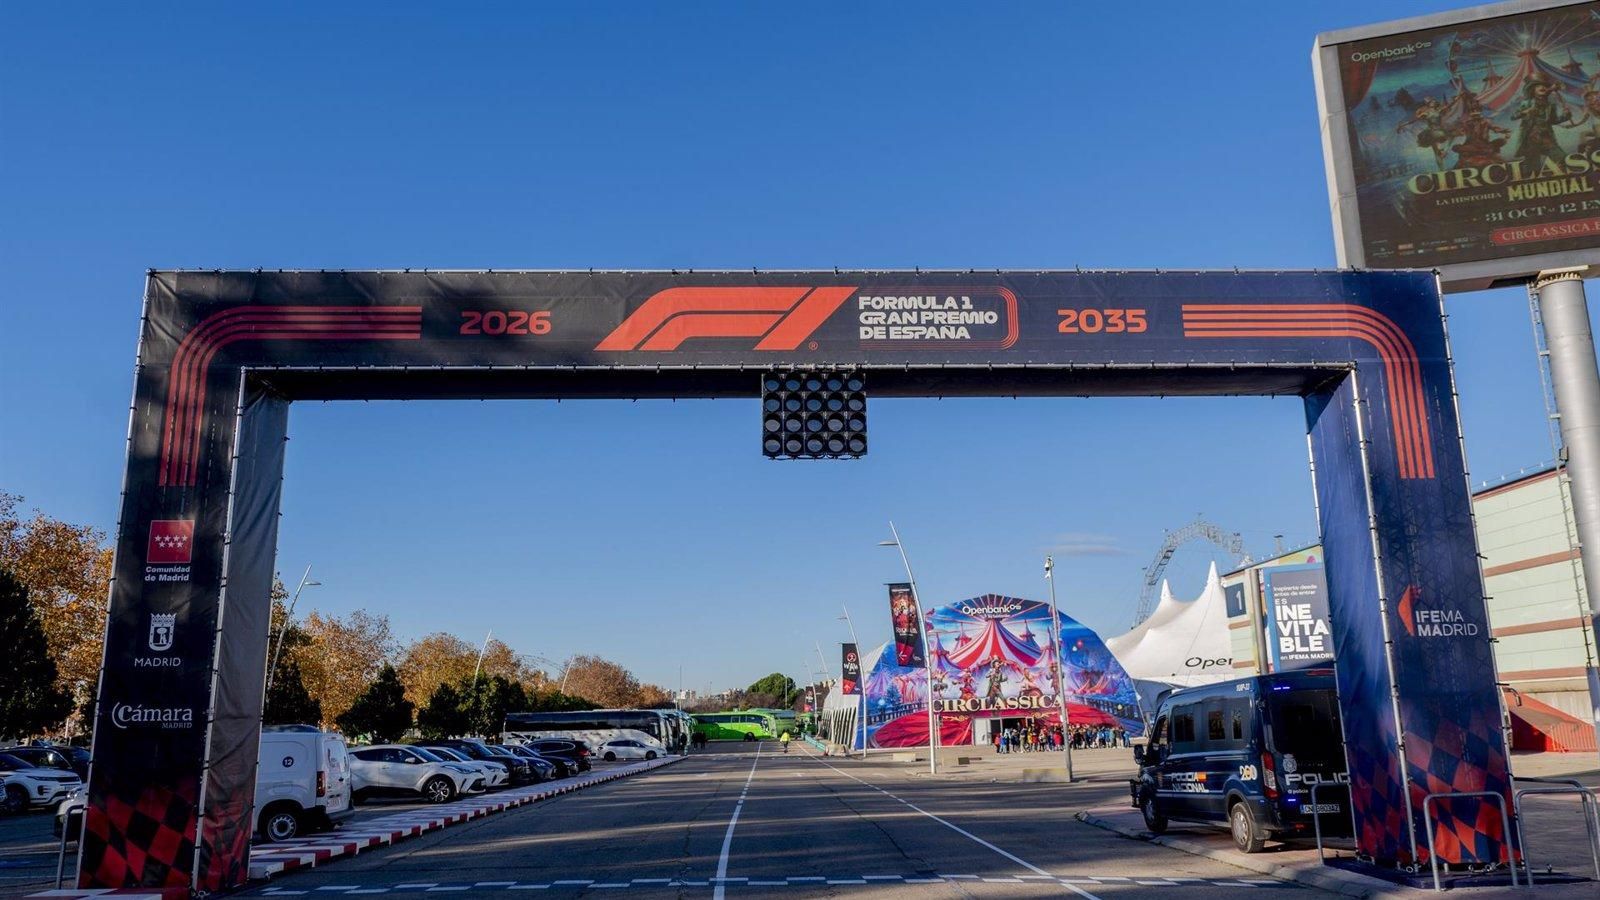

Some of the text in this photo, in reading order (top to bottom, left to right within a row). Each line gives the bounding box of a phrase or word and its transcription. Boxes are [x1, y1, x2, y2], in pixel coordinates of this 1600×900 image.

[1351, 45, 1416, 62] Openbank
[1508, 176, 1594, 201] MUNDIAL
[1451, 193, 1502, 204] HISTORIA
[1486, 212, 1504, 222] 31
[1508, 206, 1546, 219] OCT
[1559, 203, 1577, 213] 12
[858, 296, 973, 310] FORMULA 1
[460, 310, 552, 336] 2026
[859, 311, 999, 325] GRAN PREMIO
[1057, 308, 1148, 334] 2035
[859, 325, 971, 340] DE ESPAÑA
[158, 574, 190, 582] Madrid
[1236, 590, 1243, 611] 1
[962, 604, 1010, 616] Openbank
[1275, 604, 1312, 621] INE
[1415, 610, 1464, 623] IFEMA
[1277, 619, 1330, 636] VITA
[1417, 624, 1478, 637] MADRID
[1279, 635, 1324, 653] BLE
[133, 657, 182, 668] MADRID
[1288, 653, 1310, 661] IFEMA
[933, 694, 1064, 712] CIRCLASSICA
[114, 703, 193, 723] Cámara
